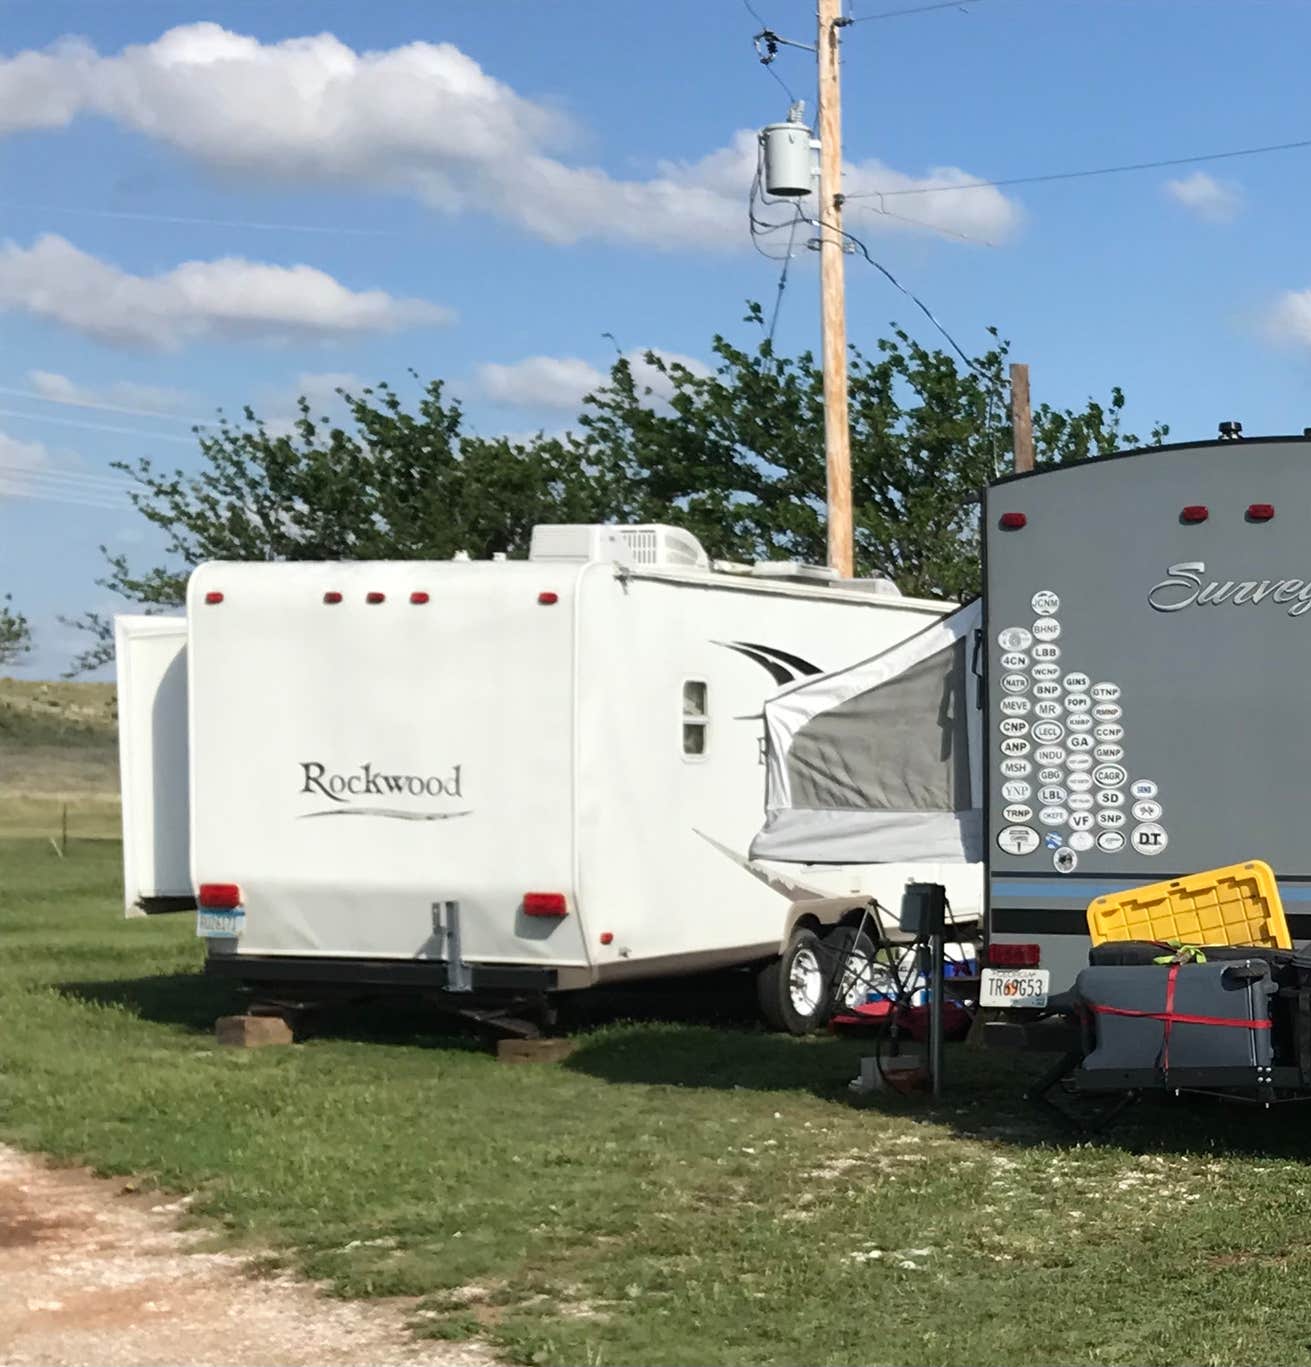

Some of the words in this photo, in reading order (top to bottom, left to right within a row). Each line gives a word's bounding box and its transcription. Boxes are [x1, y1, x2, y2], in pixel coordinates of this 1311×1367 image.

[1035, 648, 1057, 657] LBB
[1003, 656, 1026, 665] 4CN
[1037, 685, 1059, 694] BNP
[1002, 701, 1028, 711] MEVE
[1039, 704, 1056, 714] MR
[1002, 722, 1026, 732] CNP
[1096, 728, 1122, 736] CCNP
[1004, 742, 1027, 751] ANP
[1071, 737, 1089, 747] GA
[1039, 751, 1062, 760] INDU
[1005, 763, 1026, 772] MSH
[299, 761, 463, 803] Rockwood
[1006, 786, 1029, 796] YNP
[1101, 793, 1119, 803] SD
[1006, 809, 1030, 817] TRNP
[1072, 816, 1089, 826] VF
[1100, 814, 1122, 823] SNP
